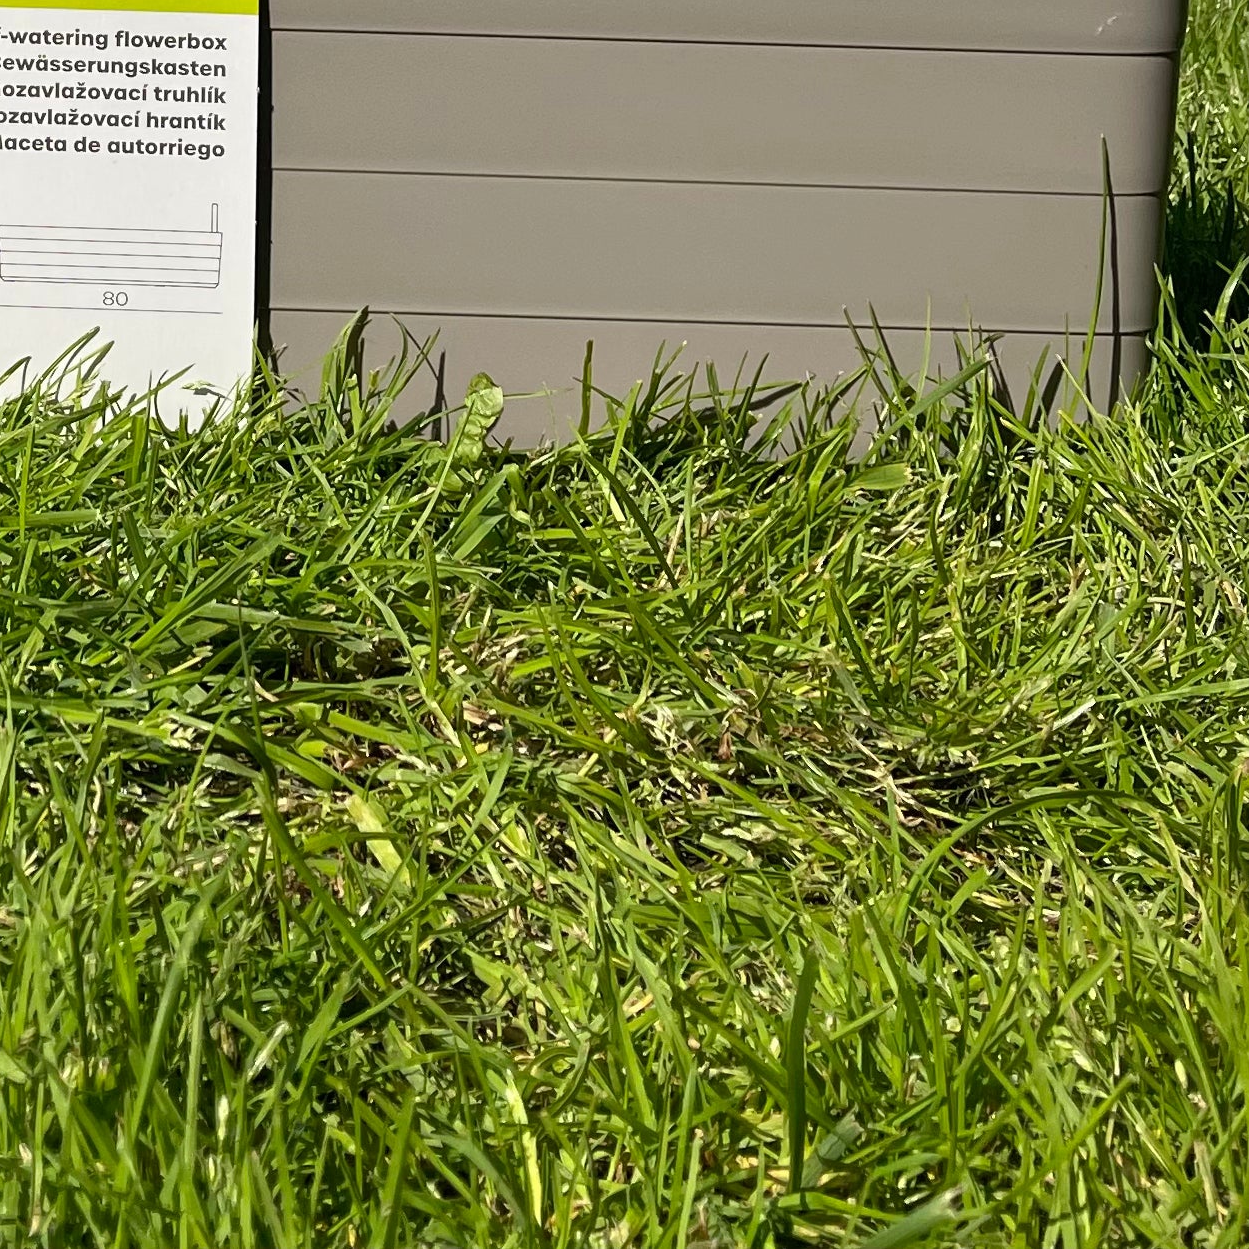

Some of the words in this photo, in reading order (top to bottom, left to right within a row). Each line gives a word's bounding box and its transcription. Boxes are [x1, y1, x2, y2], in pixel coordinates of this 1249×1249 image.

[115, 30, 228, 50] flowerbox
[153, 85, 227, 104] truhlík
[146, 111, 226, 131] hrantík
[73, 136, 101, 153] de
[107, 138, 226, 160] autorriego
[103, 291, 129, 307] 80
